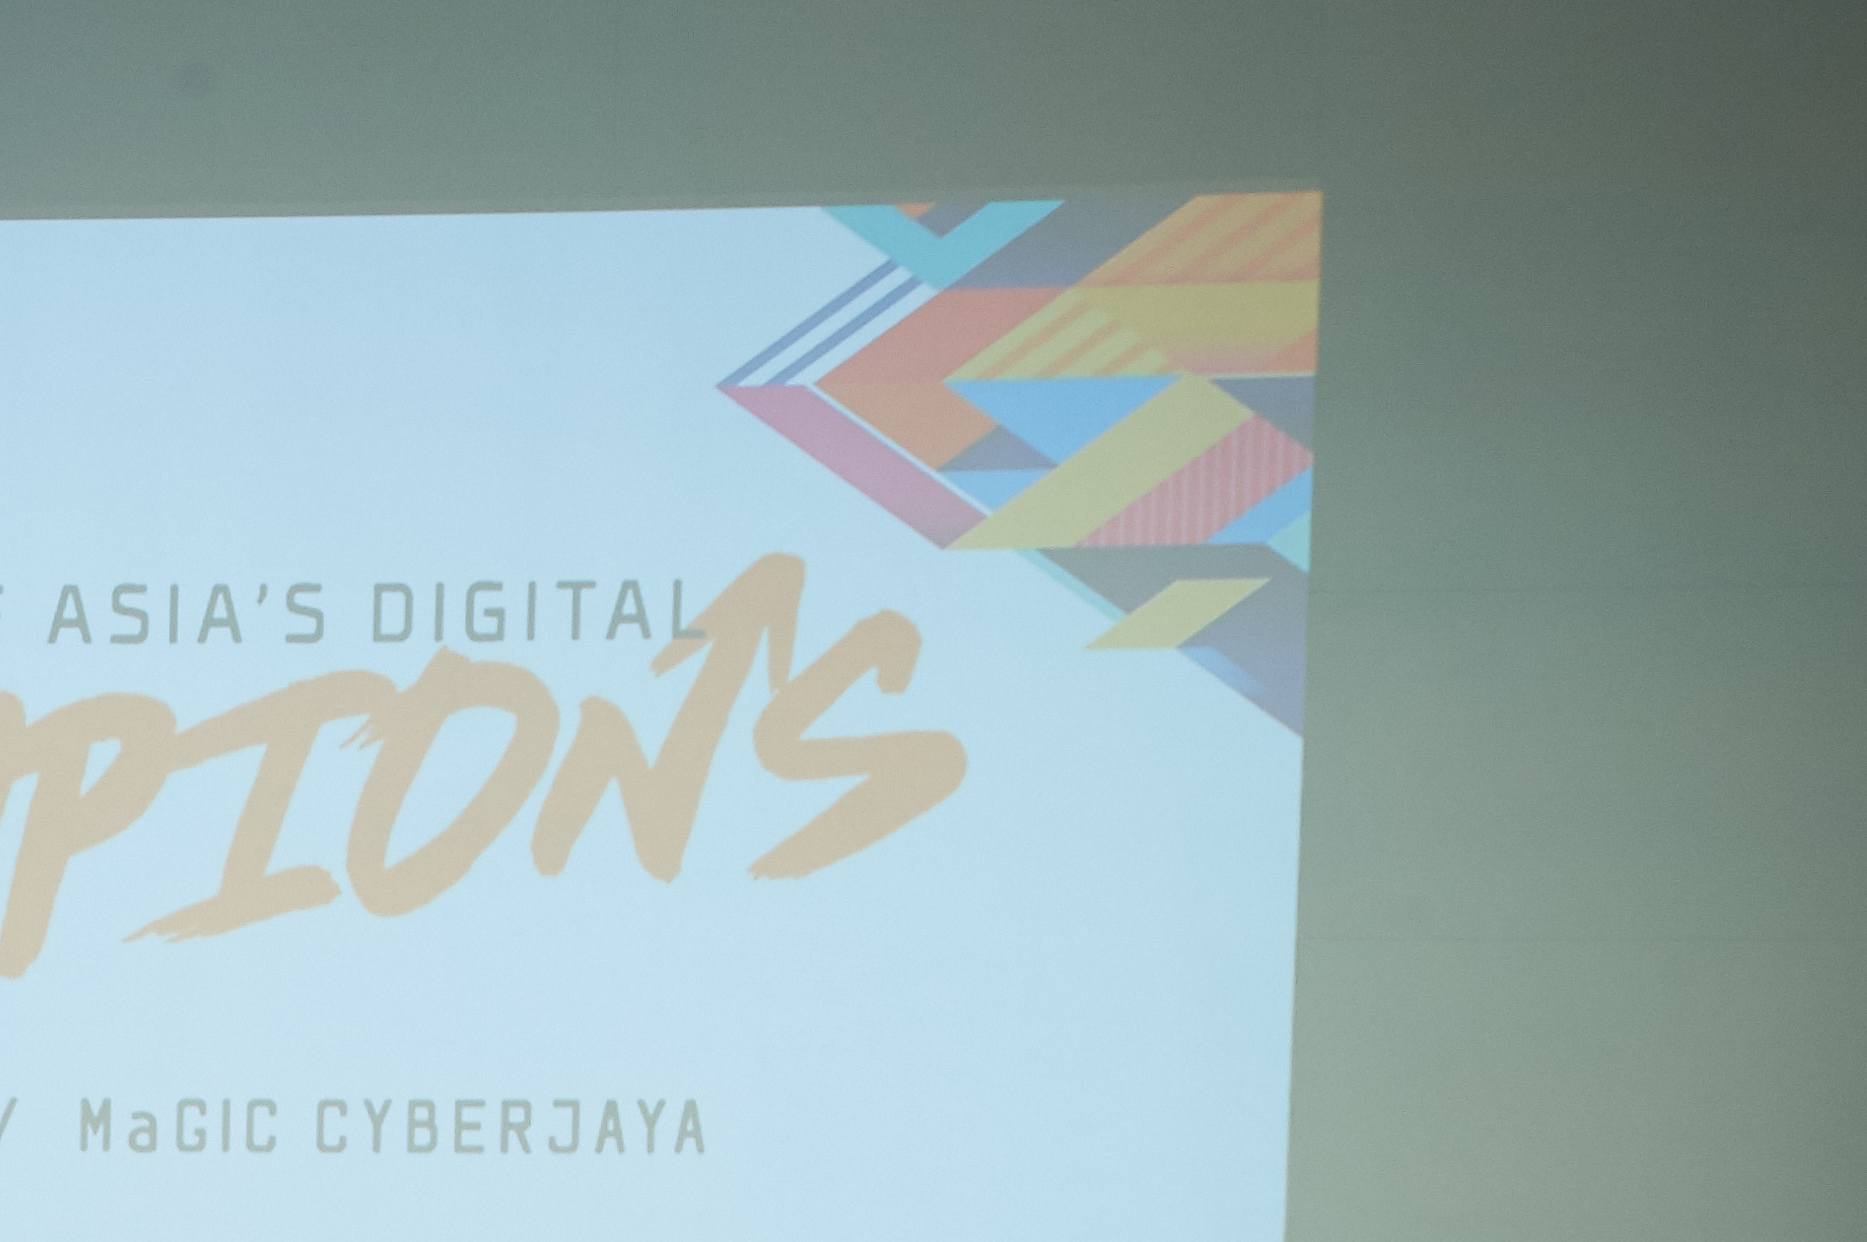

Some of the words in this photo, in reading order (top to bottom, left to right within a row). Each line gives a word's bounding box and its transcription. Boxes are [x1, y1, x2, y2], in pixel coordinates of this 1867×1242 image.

[47, 582, 324, 644] ASIA'S
[373, 579, 707, 642] DIGITAL
[80, 1099, 277, 1152] MaGIC
[317, 1098, 706, 1153] CYBERJAYA
